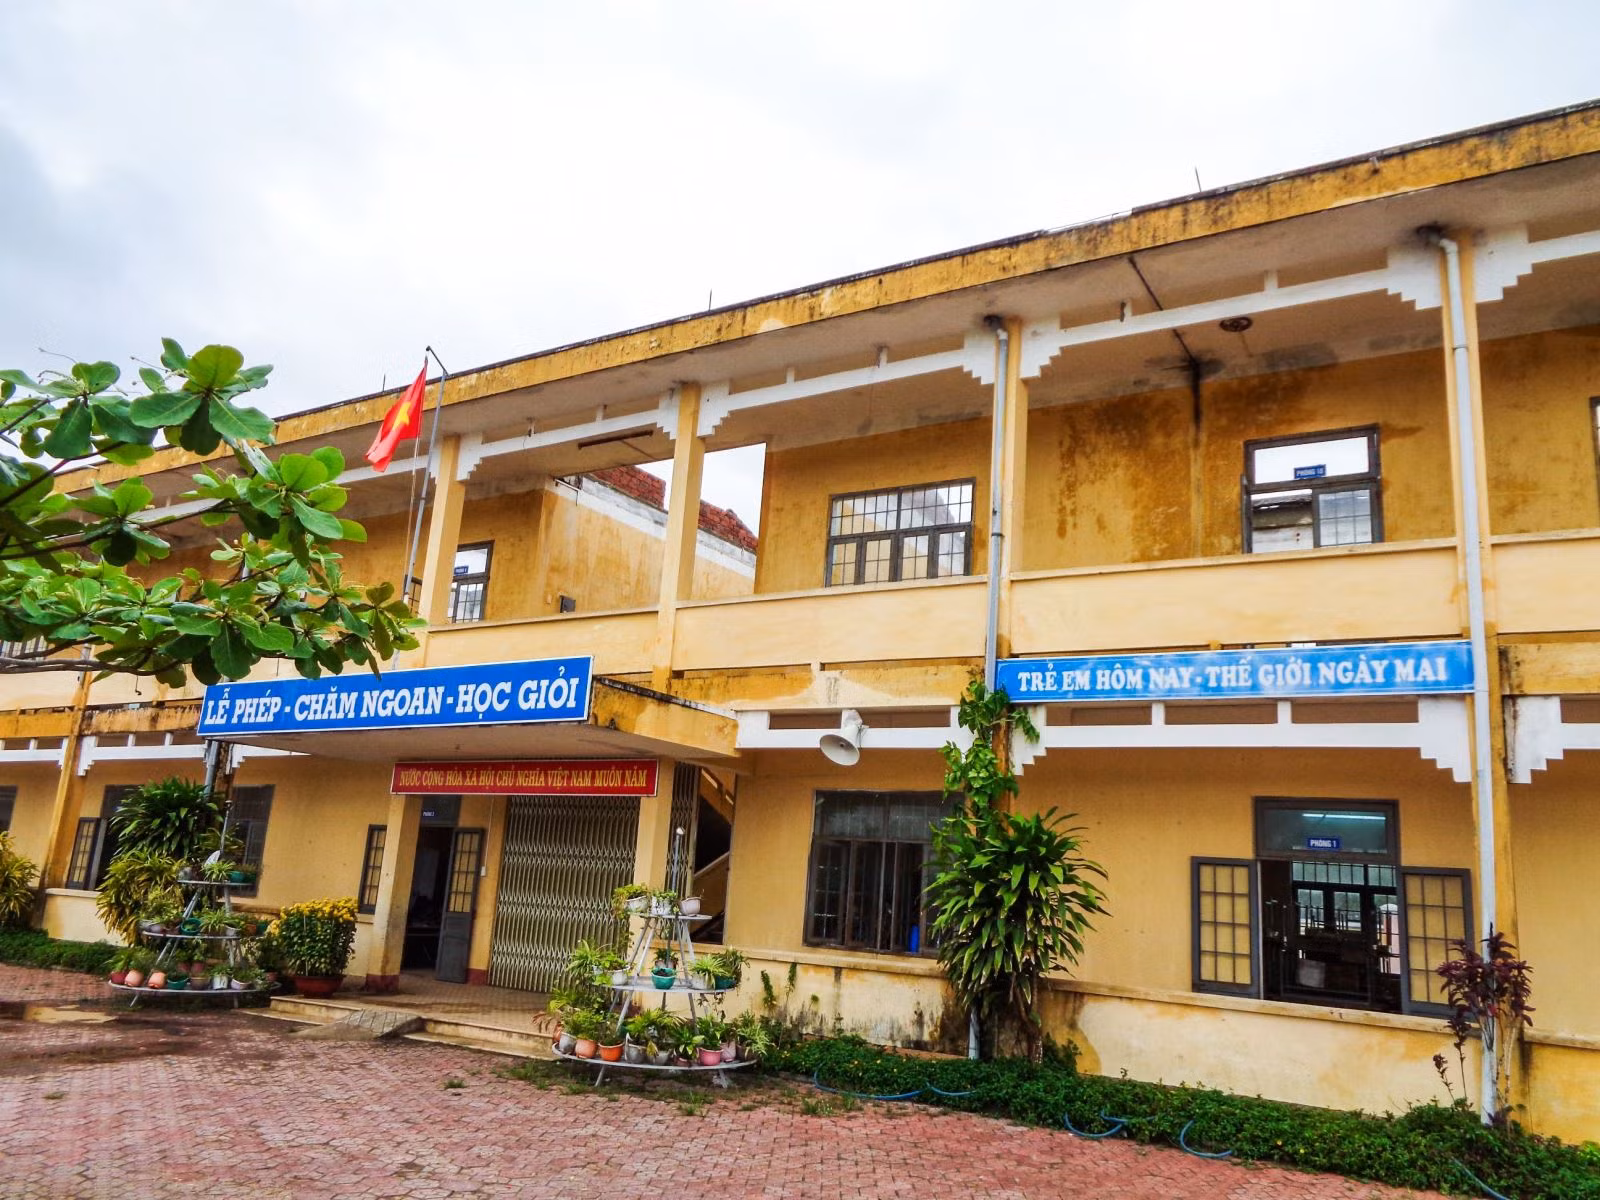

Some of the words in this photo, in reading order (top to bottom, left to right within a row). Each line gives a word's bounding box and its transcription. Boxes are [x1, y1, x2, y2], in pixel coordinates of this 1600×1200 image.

[1017, 663, 1057, 692] TRẺ
[1061, 670, 1091, 691] EM
[1096, 663, 1143, 691] HÔM
[1146, 666, 1195, 689] NAY
[1205, 656, 1252, 688] THẾ
[1258, 656, 1312, 687] GIỚI
[1317, 654, 1389, 685] NGÀY
[1393, 656, 1447, 683] MAI
[204, 687, 231, 725] LỄ
[231, 689, 282, 724] PHÉP
[294, 685, 358, 721] CHĂM
[360, 686, 445, 718] NGOAN
[455, 681, 512, 719] HỌC
[518, 665, 580, 711] GIỎI
[547, 766, 570, 790] VIỆT
[570, 770, 592, 787] NAM
[624, 765, 648, 787] NĂM
